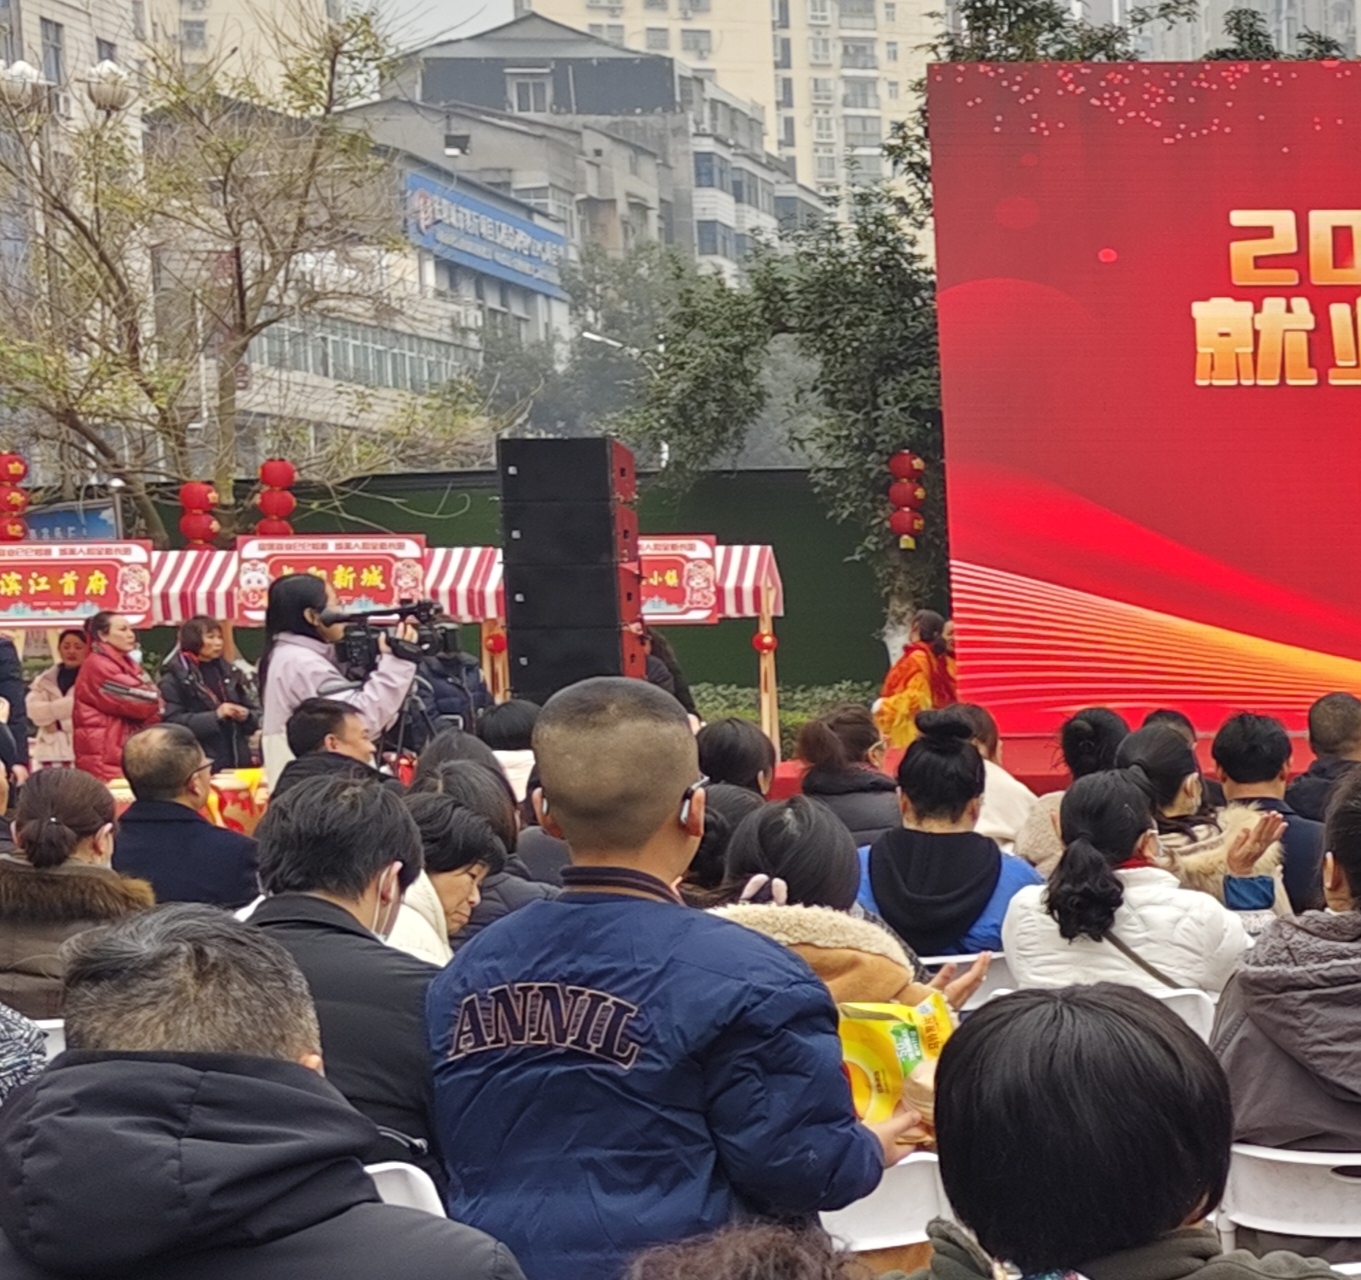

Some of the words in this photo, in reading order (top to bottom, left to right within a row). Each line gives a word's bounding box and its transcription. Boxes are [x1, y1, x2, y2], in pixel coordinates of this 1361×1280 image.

[0, 569, 109, 596] 滨江首府
[444, 981, 643, 1071] ANNIL
